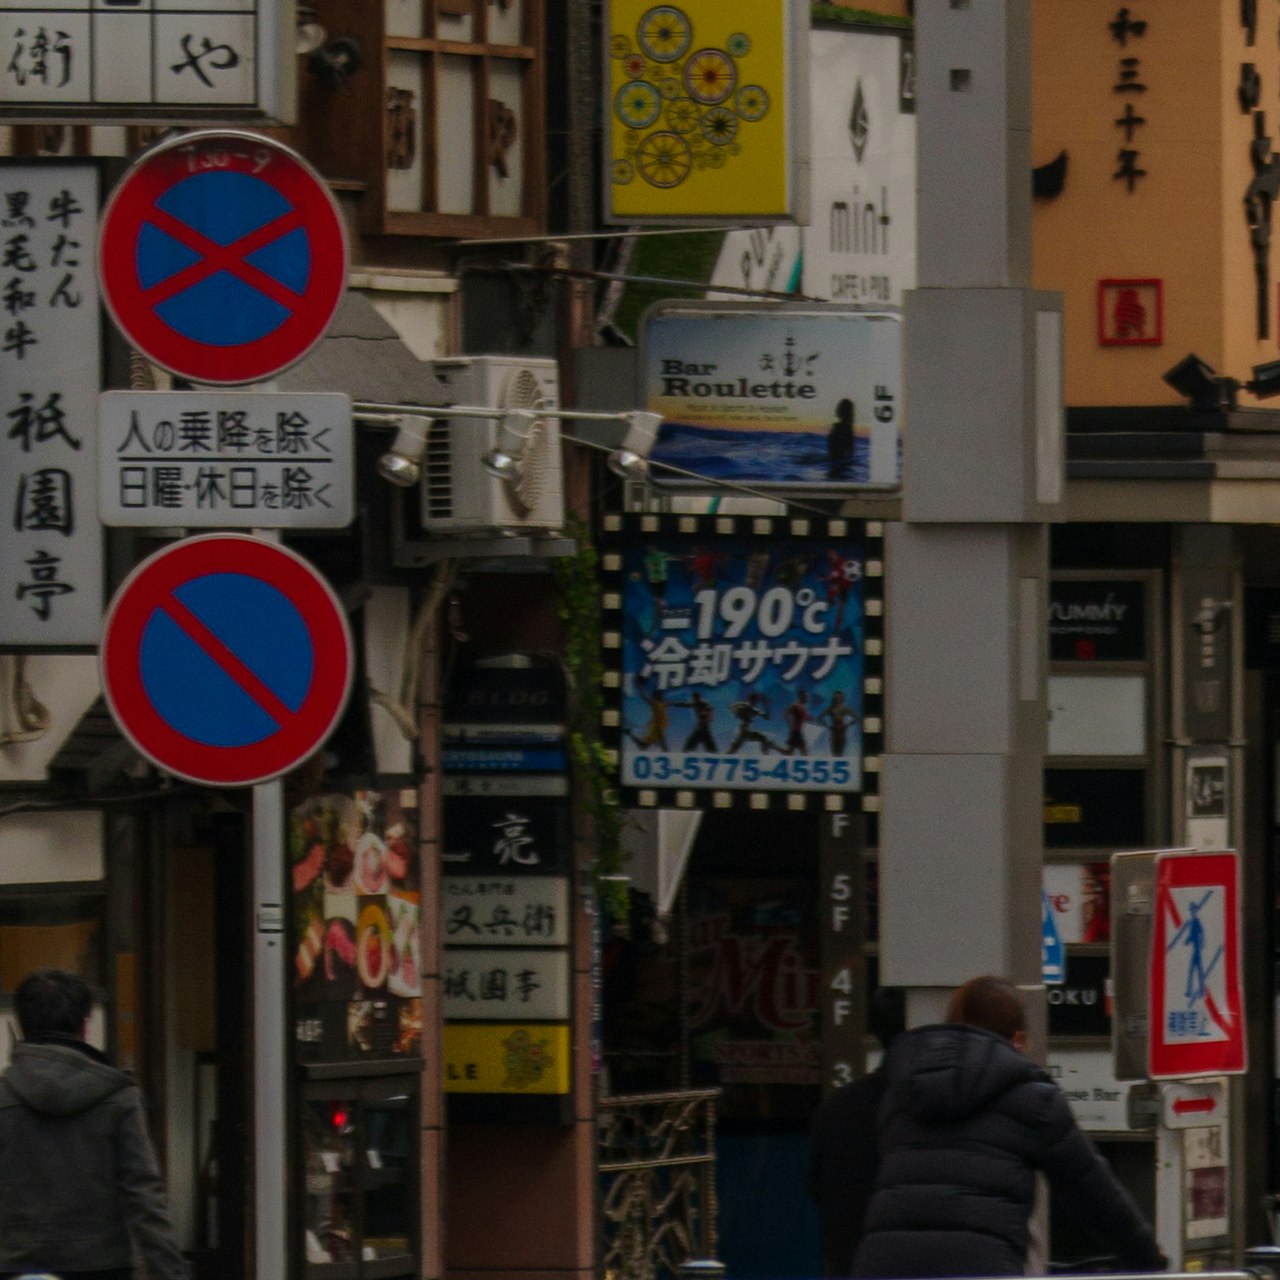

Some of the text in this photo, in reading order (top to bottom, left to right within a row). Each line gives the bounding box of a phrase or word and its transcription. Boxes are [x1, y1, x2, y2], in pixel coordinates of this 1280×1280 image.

[169, 33, 239, 89] や
[47, 190, 82, 308] 牛たん
[1, 191, 38, 360] 黒毛和牛
[661, 359, 717, 376] Bar
[661, 378, 816, 399] Roulette
[116, 410, 332, 454] 人の乗降を除く
[7, 392, 82, 621] 祇園亭
[119, 466, 333, 509] 日曜・休日を除く
[640, 636, 852, 691] 冷却サウナ
[633, 756, 850, 785] 03-5775-4555
